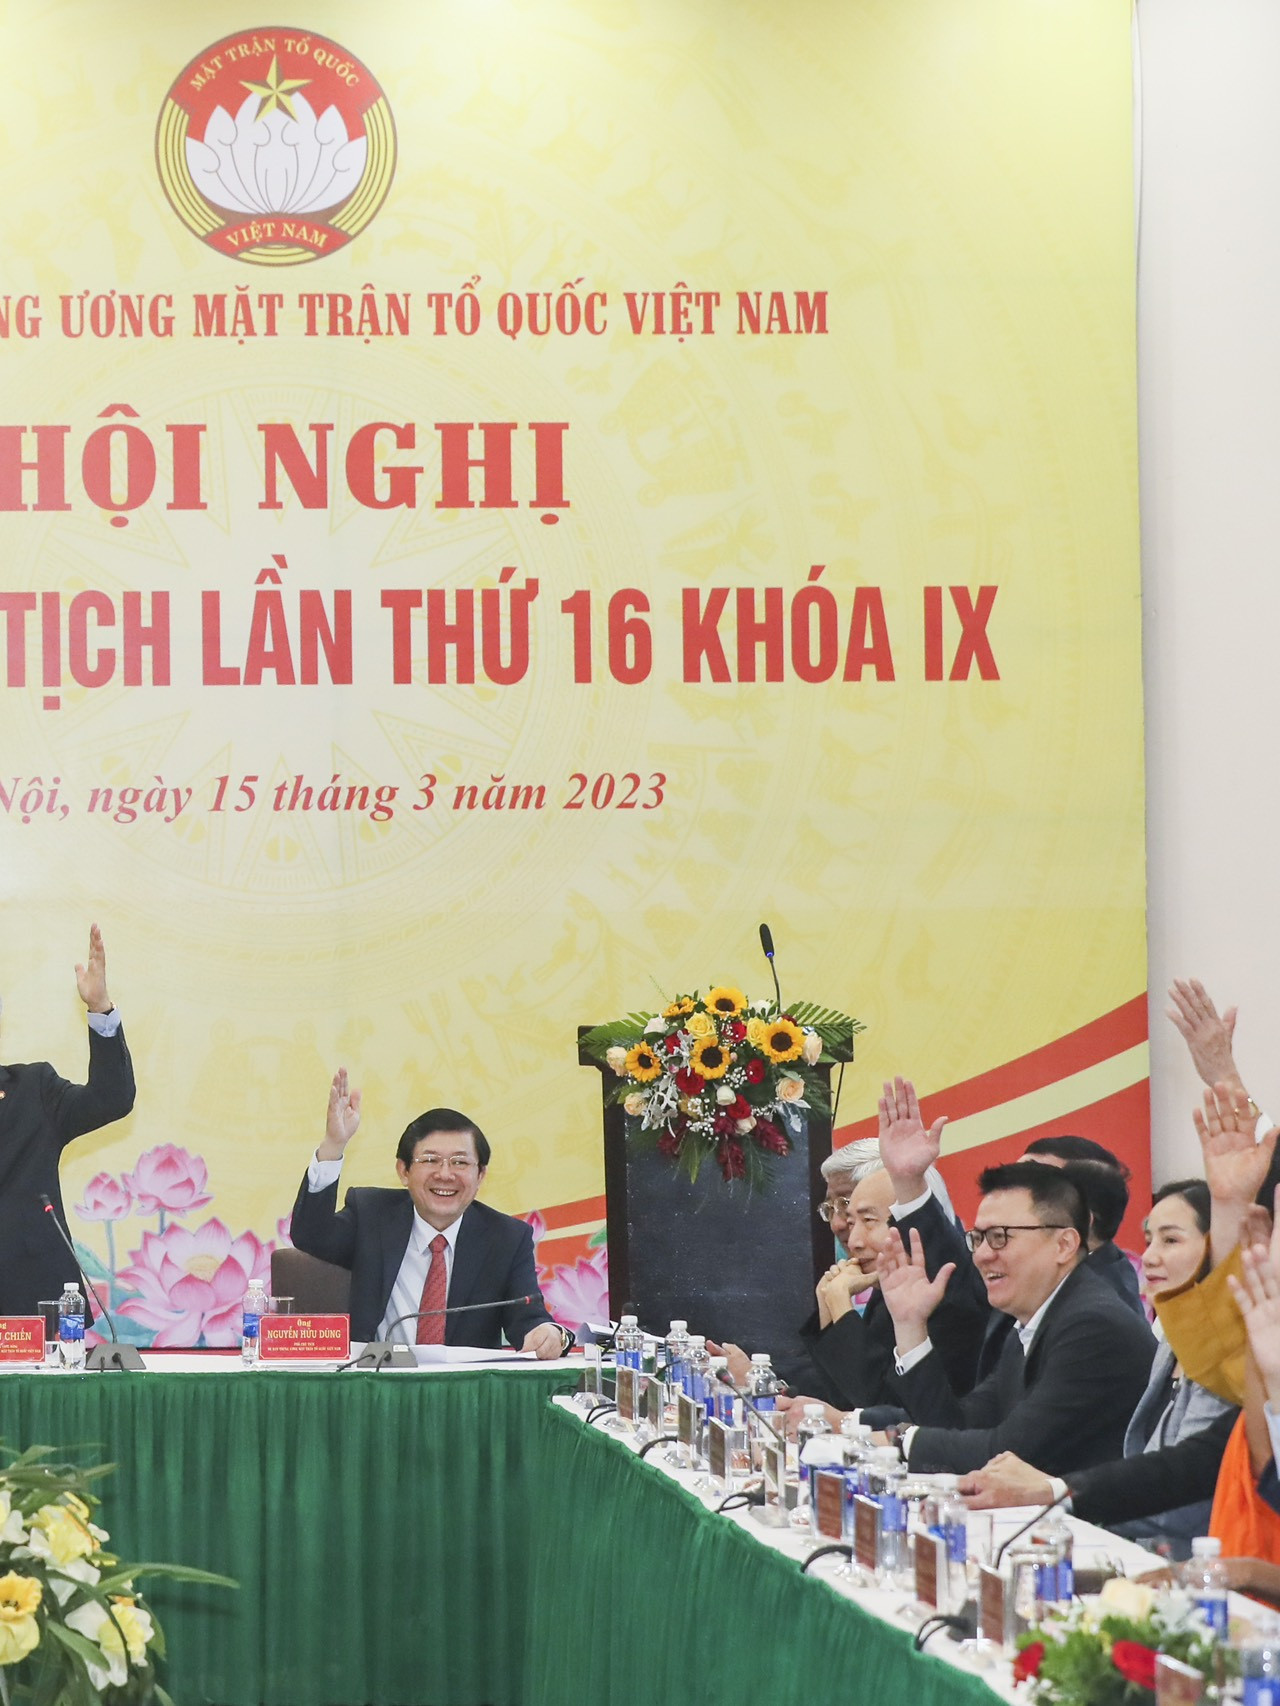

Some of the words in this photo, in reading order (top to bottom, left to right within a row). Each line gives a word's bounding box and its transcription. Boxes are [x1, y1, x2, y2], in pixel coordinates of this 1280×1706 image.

[189, 58, 223, 91] MẶT
[225, 36, 277, 63] TRẬN
[284, 37, 311, 56] TỔ
[313, 49, 361, 88] QUỐC
[226, 221, 276, 248] VIỆT
[281, 222, 328, 248] NAM
[60, 289, 175, 339] ƯƠNG
[193, 285, 284, 345] MẶT
[298, 283, 411, 345] TRẬN
[427, 275, 482, 338] TỔ
[497, 277, 608, 344] QUỐC
[623, 281, 721, 343] VIỆT
[737, 290, 829, 335] NAM
[257, 421, 571, 526] NGHỊ
[201, 553, 353, 686] LẦN
[381, 566, 539, 686] THỨ
[561, 588, 653, 686] 16
[682, 564, 896, 685] KHÓA
[923, 585, 1001, 682] IX
[87, 775, 193, 824] ngày
[208, 775, 259, 812] 15
[273, 773, 399, 822] tháng
[412, 773, 438, 811] 3
[452, 773, 547, 811] năm
[563, 772, 667, 811] 2023
[4, 1327, 32, 1341] CHIẾN
